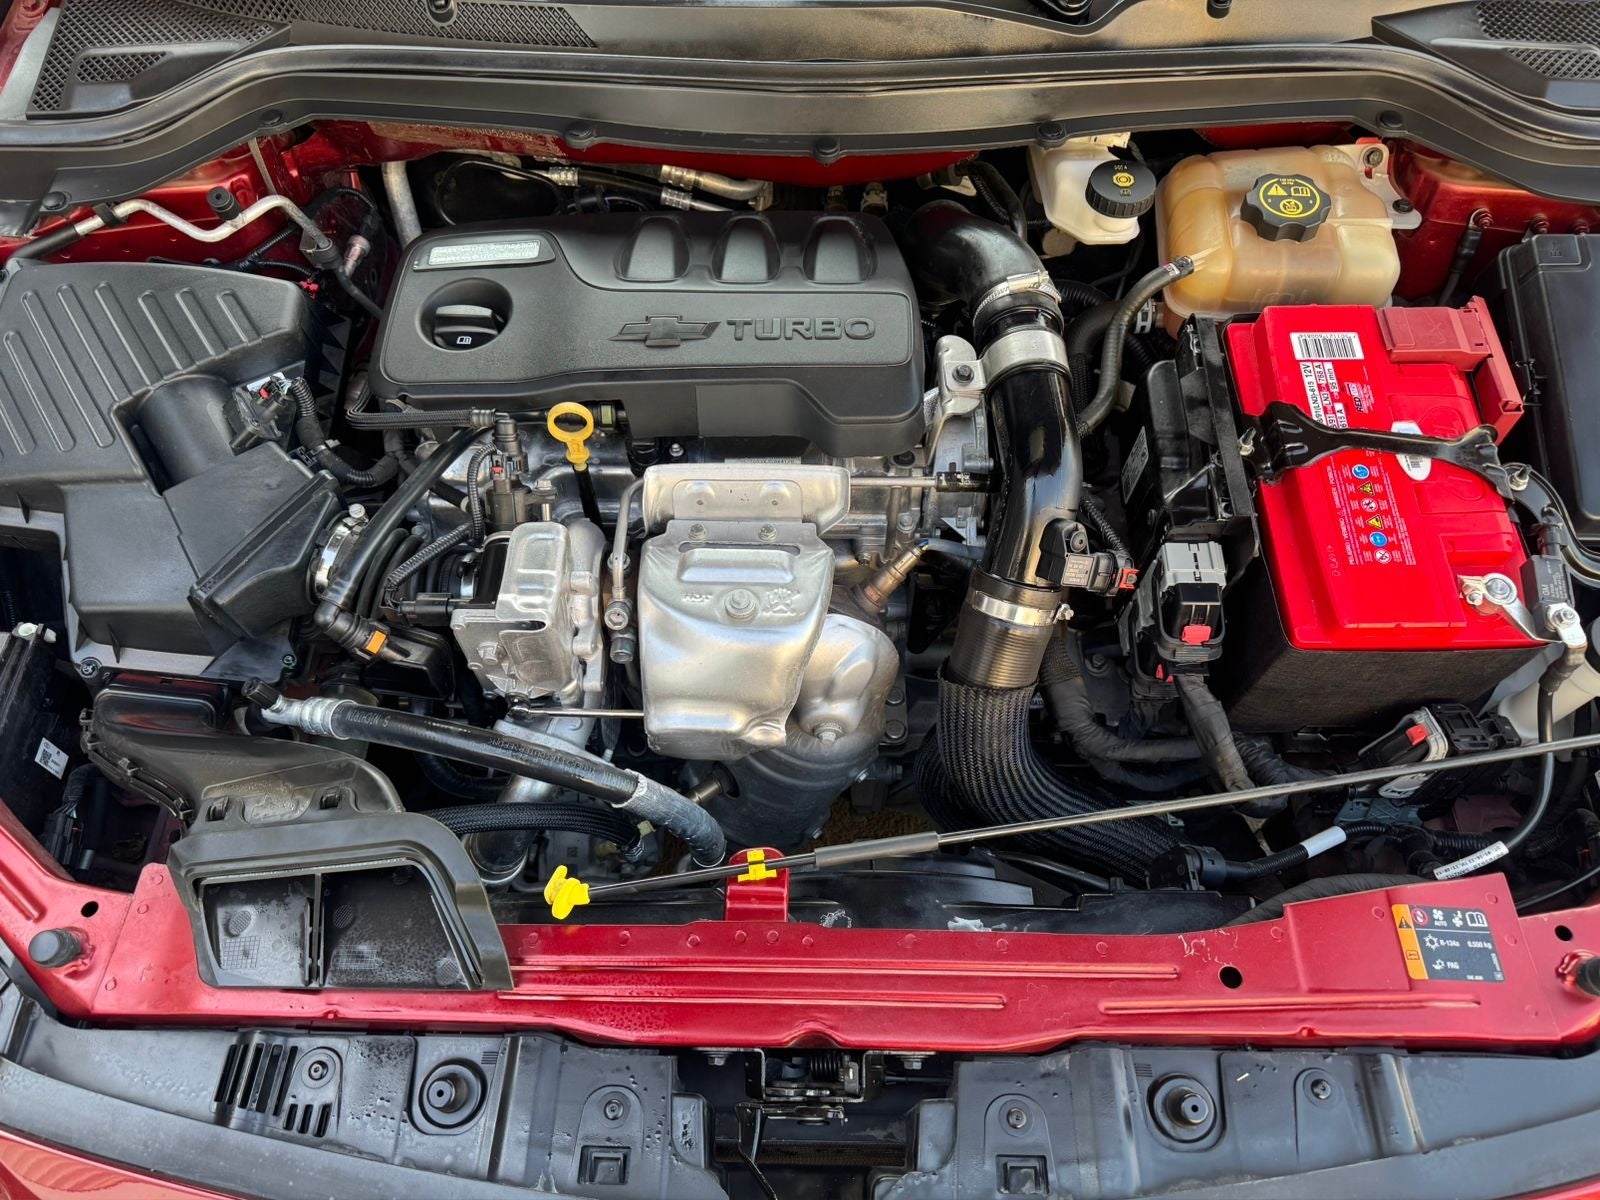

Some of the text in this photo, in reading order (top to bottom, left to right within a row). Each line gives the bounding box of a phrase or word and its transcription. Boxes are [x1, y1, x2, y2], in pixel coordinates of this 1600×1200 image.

[726, 317, 876, 341] TURBO
[1302, 363, 1313, 378] 12V
[1327, 368, 1335, 380] min
[1321, 392, 1331, 405] LN3
[1353, 396, 1364, 413] RED
[1541, 584, 1550, 596] GM
[1484, 941, 1492, 949] kg
